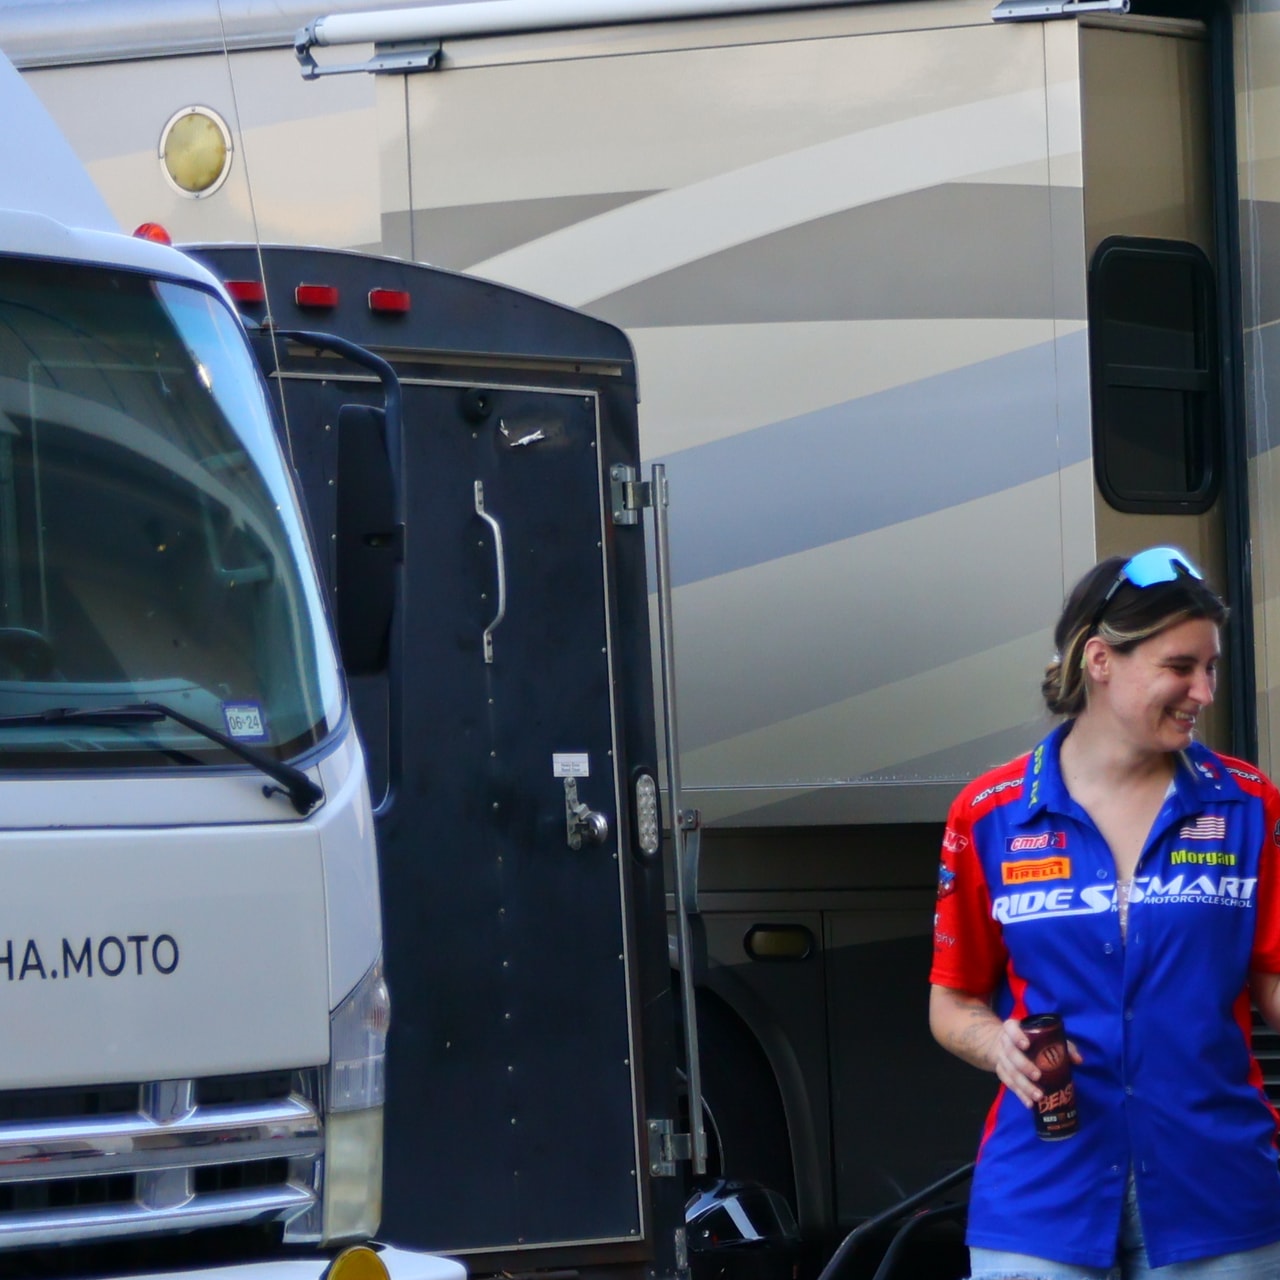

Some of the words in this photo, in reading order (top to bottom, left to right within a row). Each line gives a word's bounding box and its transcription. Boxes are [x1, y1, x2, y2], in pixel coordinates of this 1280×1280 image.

[1010, 833, 1049, 852] cmra
[1170, 850, 1237, 866] Morgan
[1006, 861, 1063, 880] PIRELLI
[992, 888, 1075, 924] RIDE
[1143, 895, 1220, 905] MOTORCYCLE
